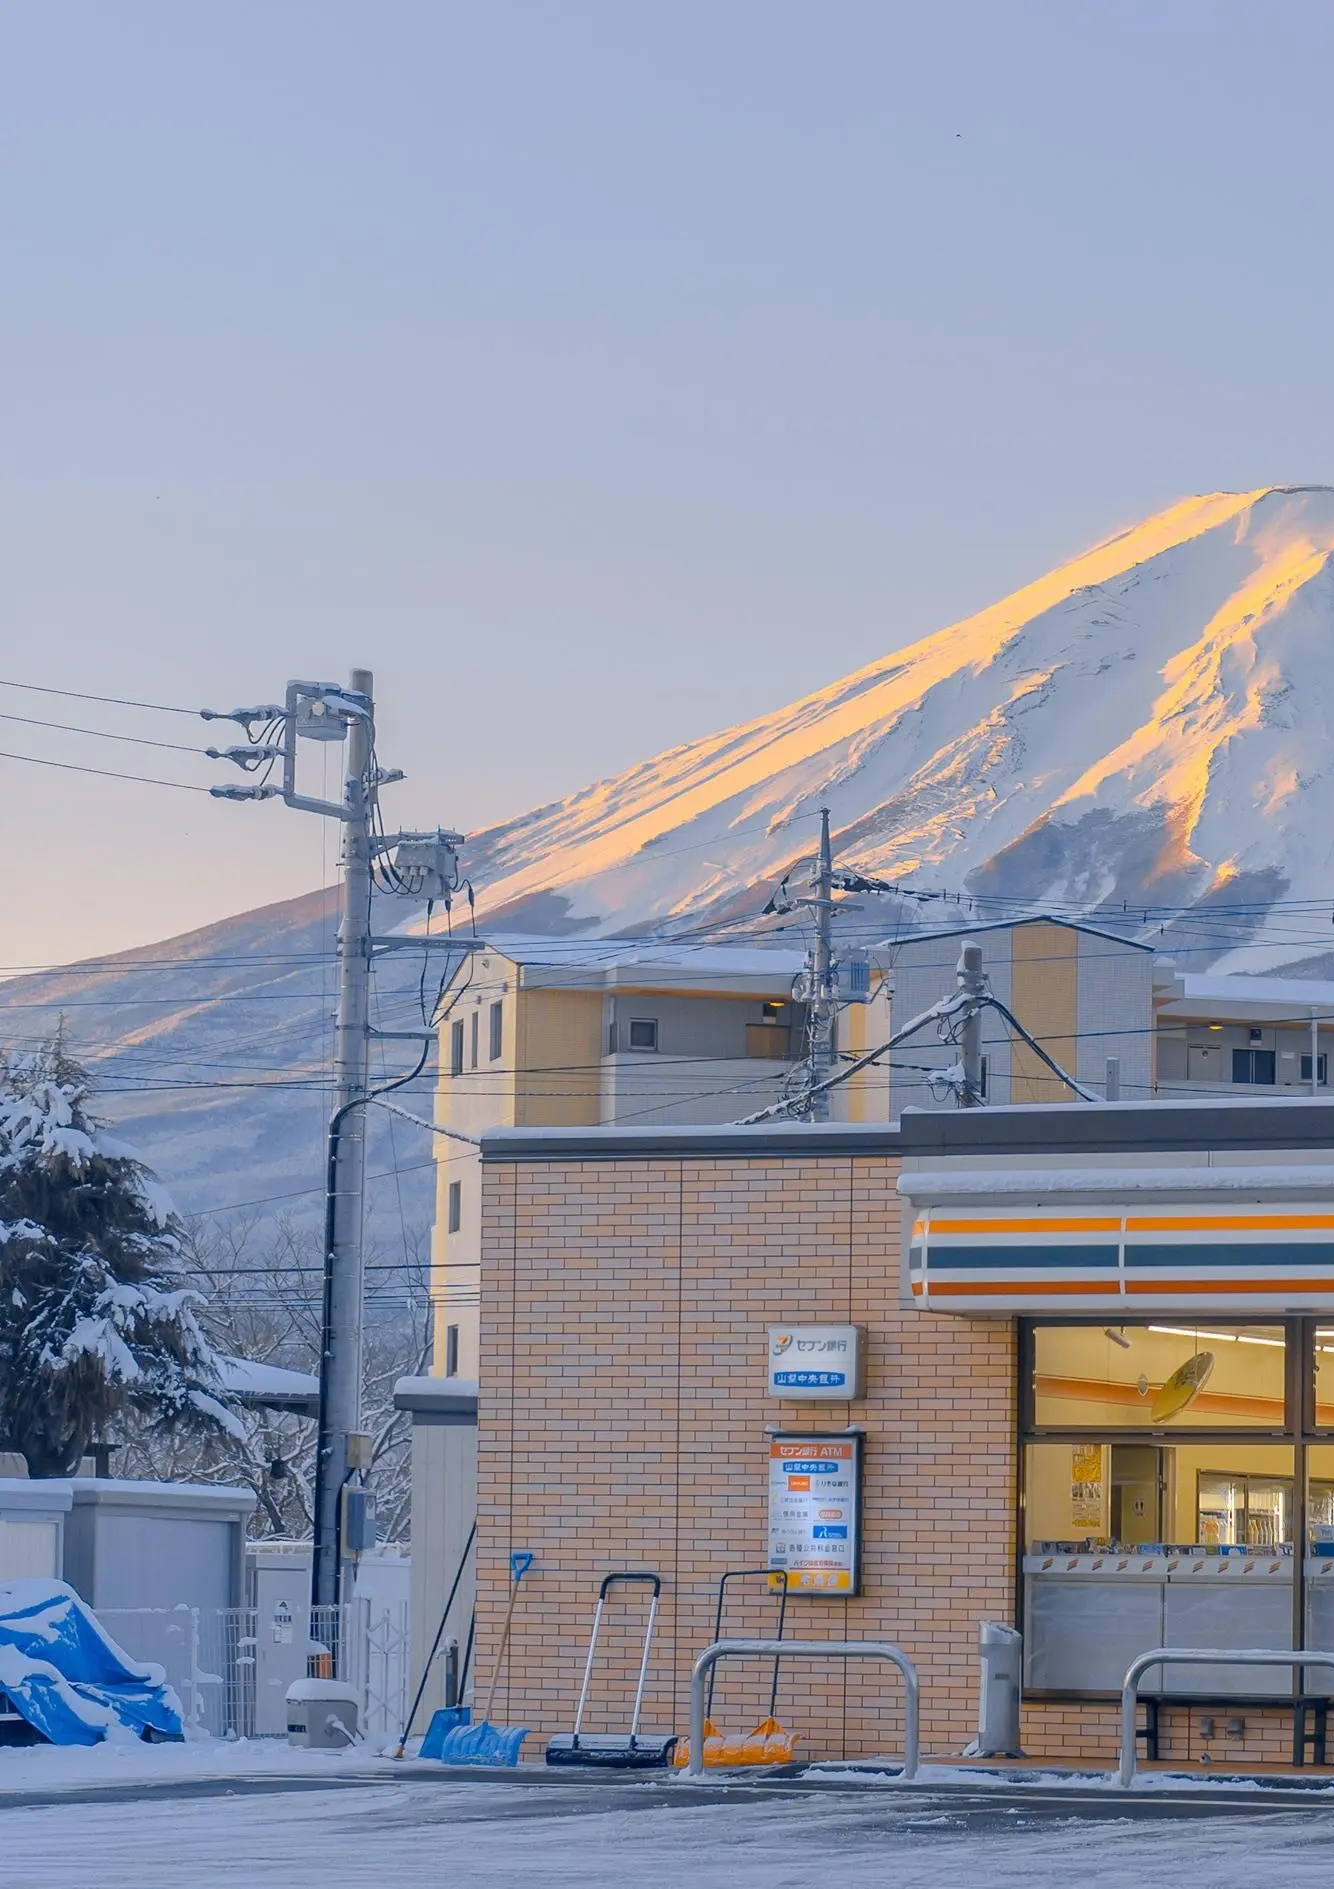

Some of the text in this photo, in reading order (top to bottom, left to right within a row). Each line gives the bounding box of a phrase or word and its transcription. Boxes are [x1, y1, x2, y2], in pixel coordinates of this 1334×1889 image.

[797, 1339, 847, 1352] セブン銀行
[777, 1373, 841, 1385] 山梨中央銀行
[780, 1446, 843, 1457] セブン銀行 ATM
